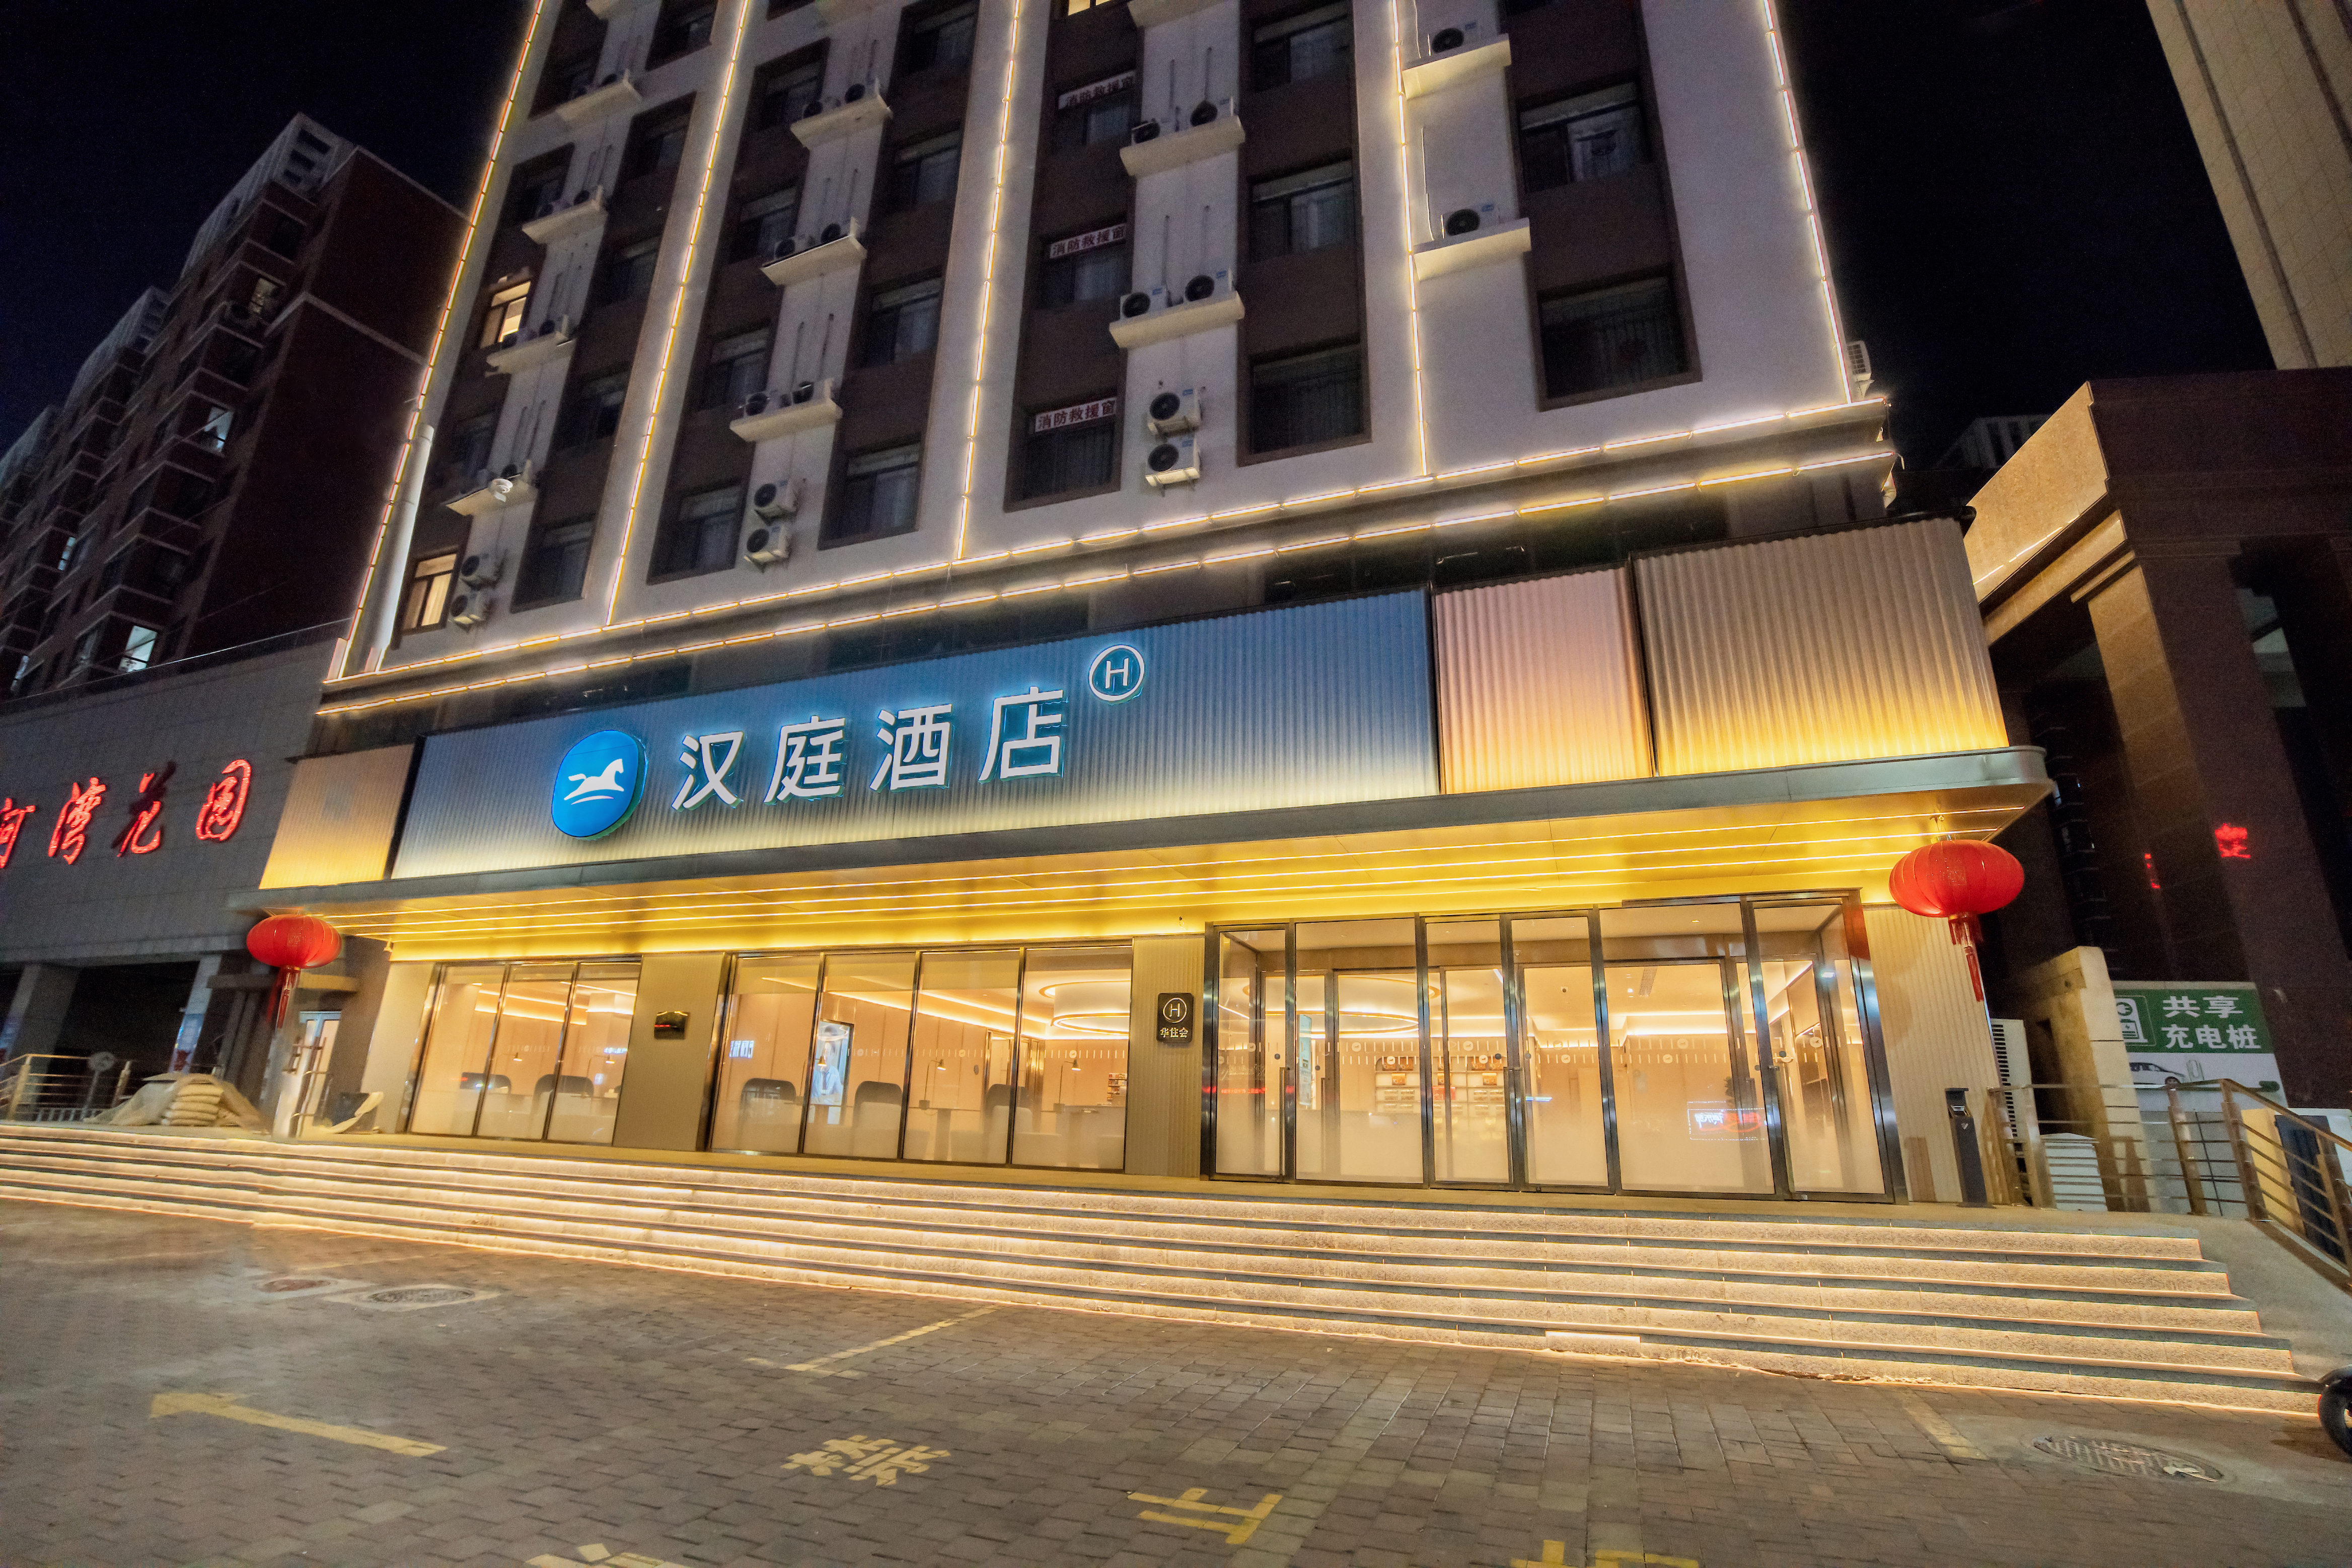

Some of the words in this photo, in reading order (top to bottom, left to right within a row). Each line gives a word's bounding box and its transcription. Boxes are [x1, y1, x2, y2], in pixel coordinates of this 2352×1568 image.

[1052, 226, 1125, 256] 消防救援窗
[1038, 400, 1116, 430] 消防救援窗
[672, 686, 1064, 811] 汉庭酒店
[2163, 995, 2243, 1019] 共享
[1160, 1027, 1189, 1038] 华住会
[2161, 1024, 2261, 1050] 充电桩
